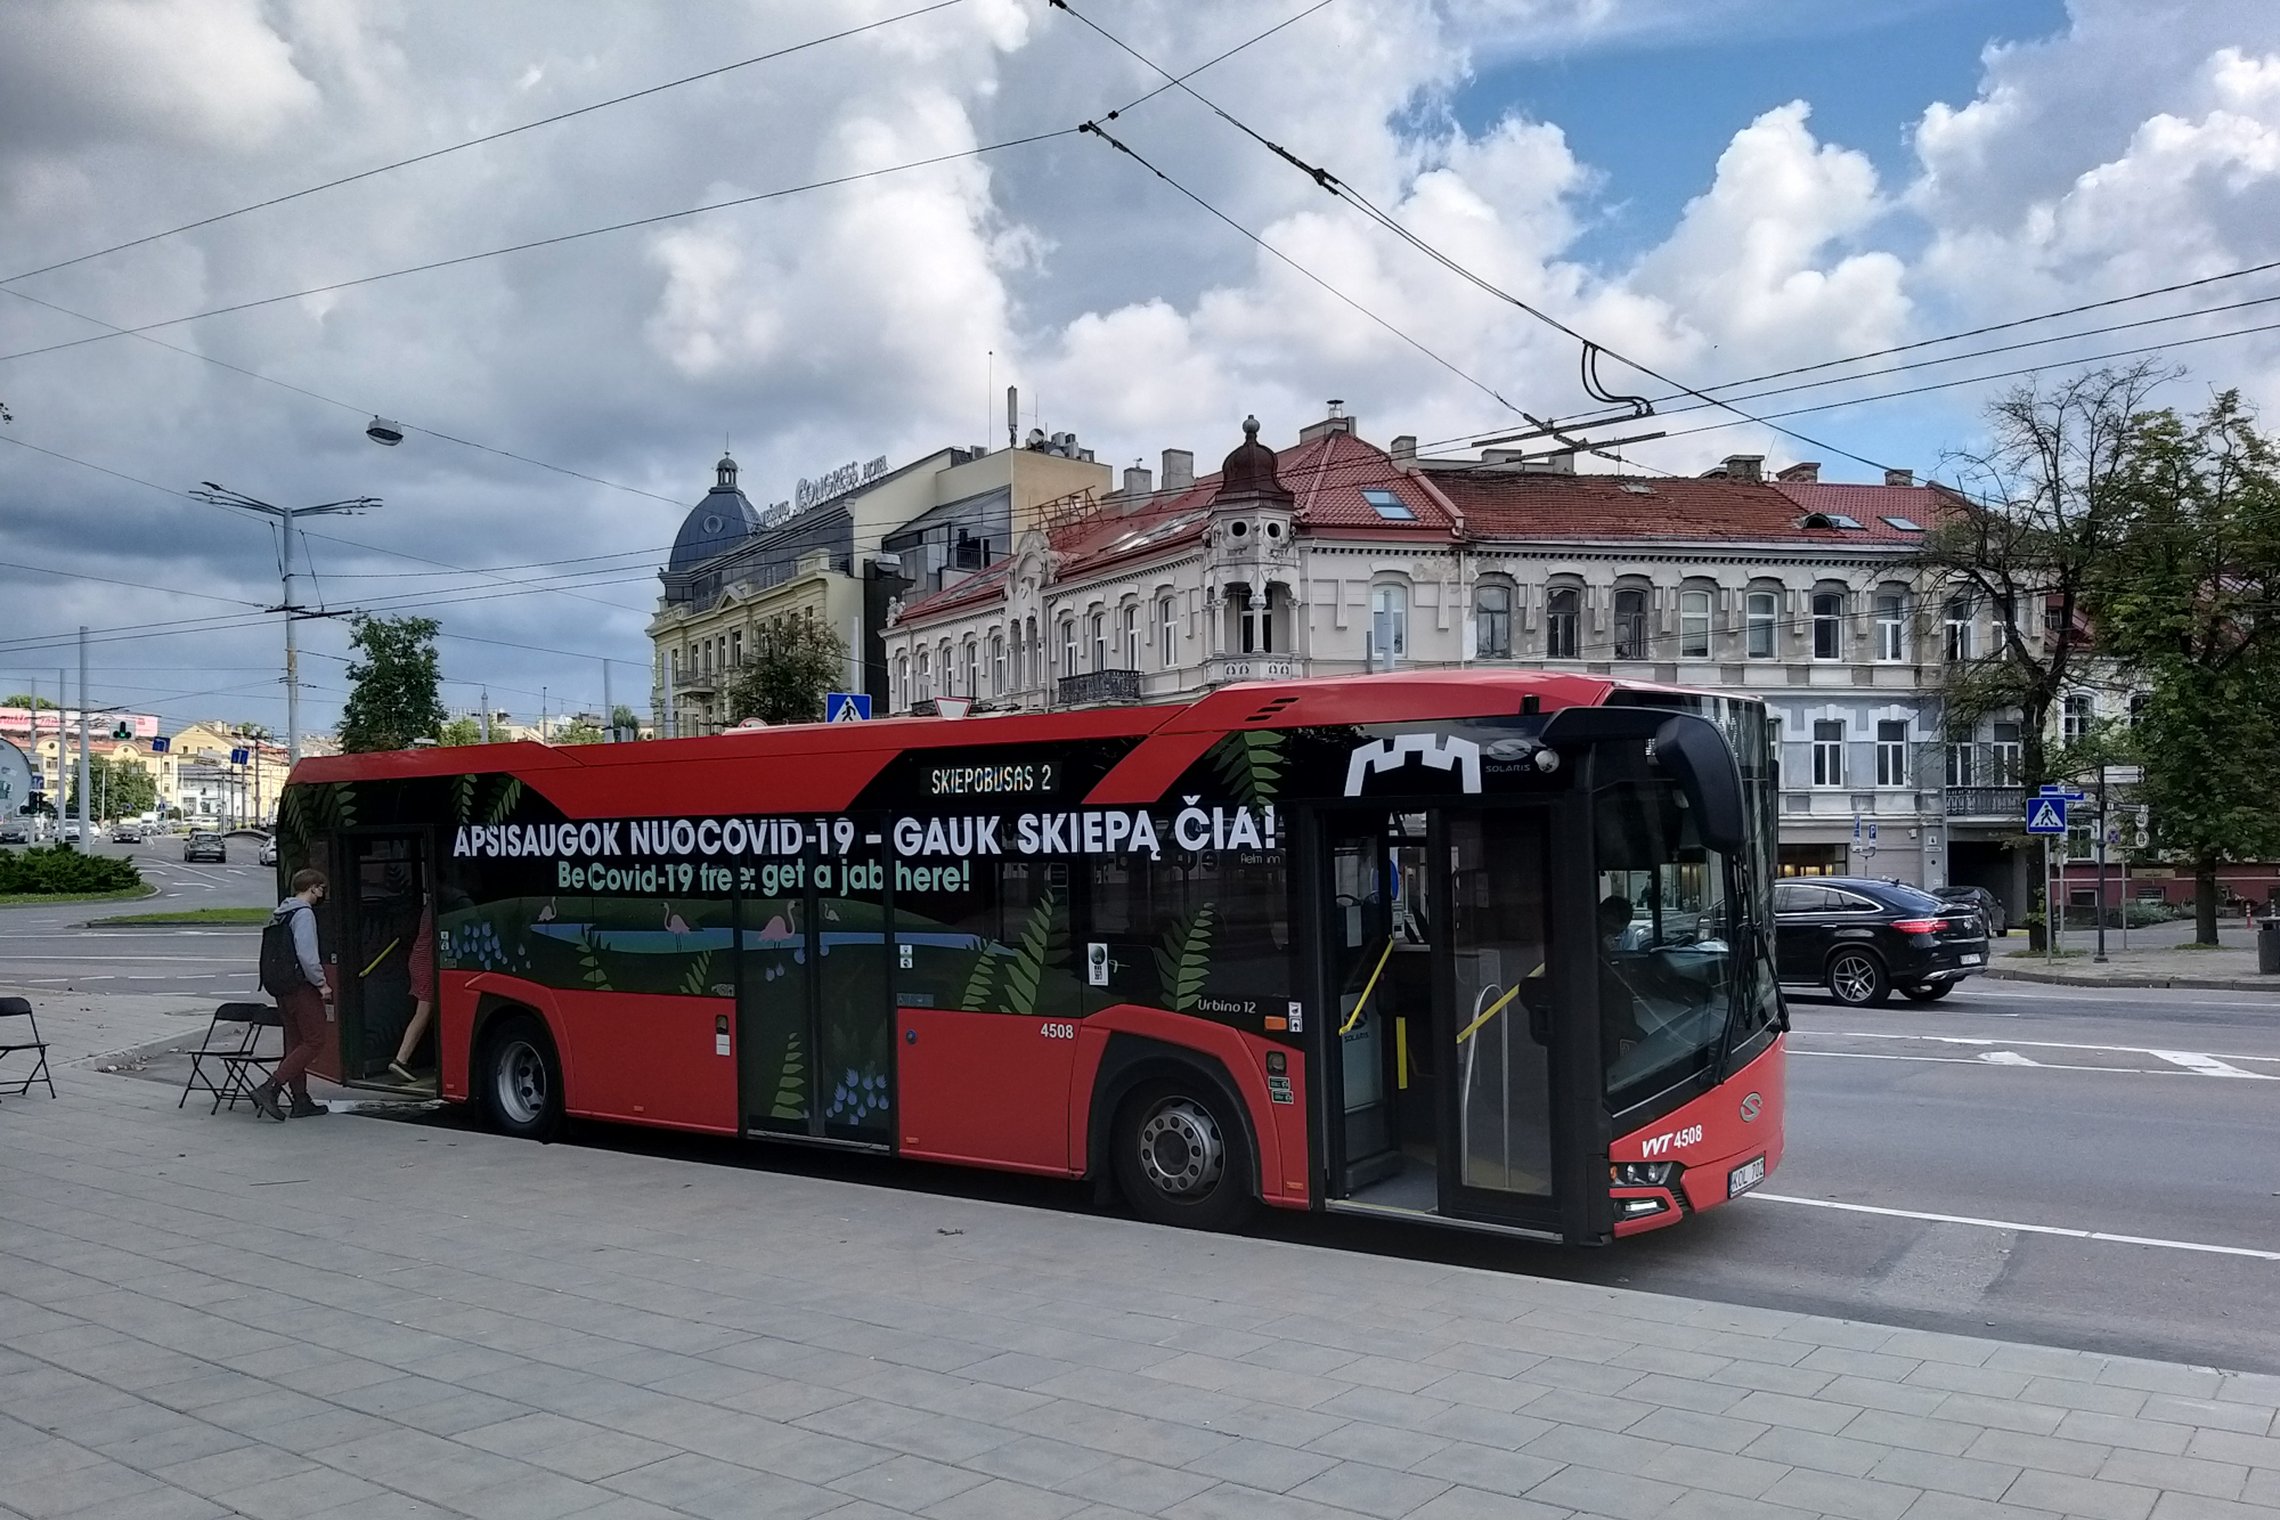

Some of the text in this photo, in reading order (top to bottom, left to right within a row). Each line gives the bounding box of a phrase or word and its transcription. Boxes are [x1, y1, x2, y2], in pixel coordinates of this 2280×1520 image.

[795, 461, 859, 512] CONGRESS
[863, 455, 888, 479] HOTEL
[931, 764, 1051, 794] SKIEPOBUSAS 2
[1485, 764, 1531, 773] SOLARIS
[453, 822, 622, 857] APSISAUGOK
[893, 815, 1002, 856] GAUK
[1017, 810, 1161, 861] SKIEPĄ
[1174, 794, 1276, 851] ČIA!
[558, 860, 585, 889] Be
[588, 862, 693, 893] Covid-19
[762, 858, 805, 897] get
[813, 865, 832, 889] a
[840, 858, 884, 897] jab
[895, 860, 970, 892] here!
[1197, 999, 1257, 1014] Urbino 12
[1041, 1023, 1074, 1039] 4508
[1673, 1124, 1702, 1149] 4508
